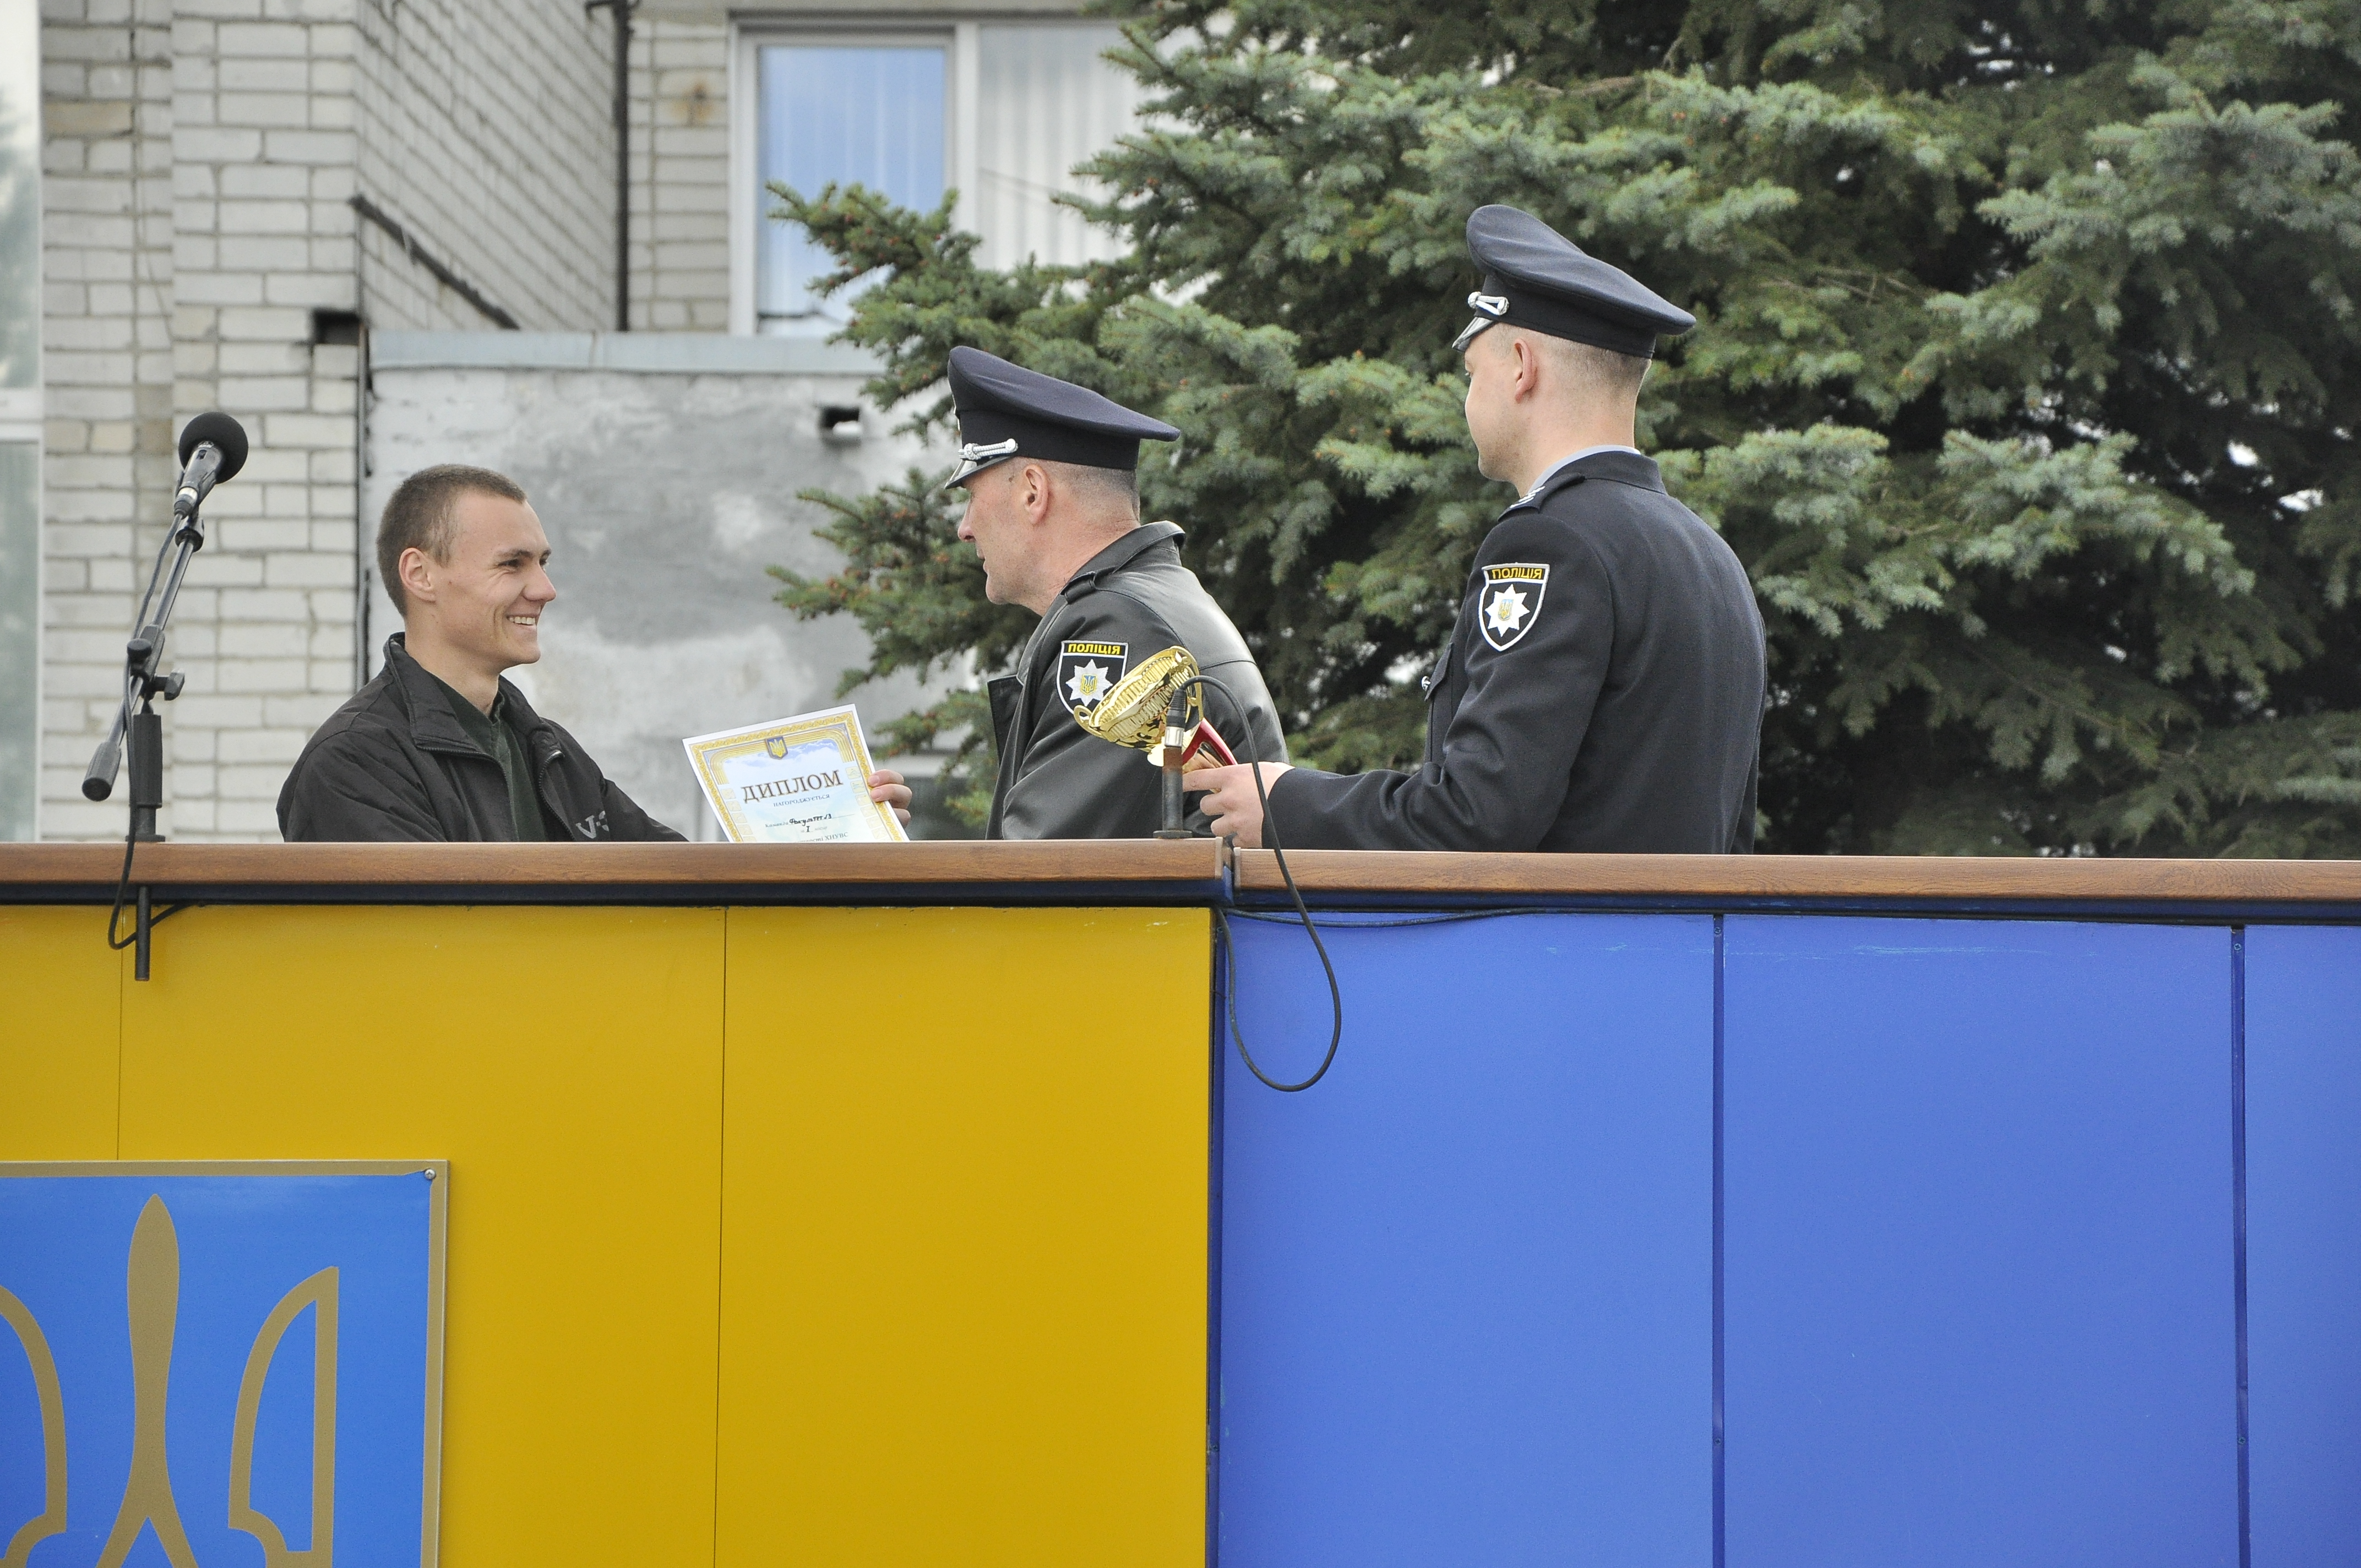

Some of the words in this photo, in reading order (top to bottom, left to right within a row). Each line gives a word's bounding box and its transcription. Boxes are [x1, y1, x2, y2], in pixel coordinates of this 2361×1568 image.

[1492, 568, 1542, 579] ПОЛІЦІЯ
[1068, 643, 1121, 655] ПОЛІЦІЯ
[740, 769, 844, 804] ДИПЛОМ
